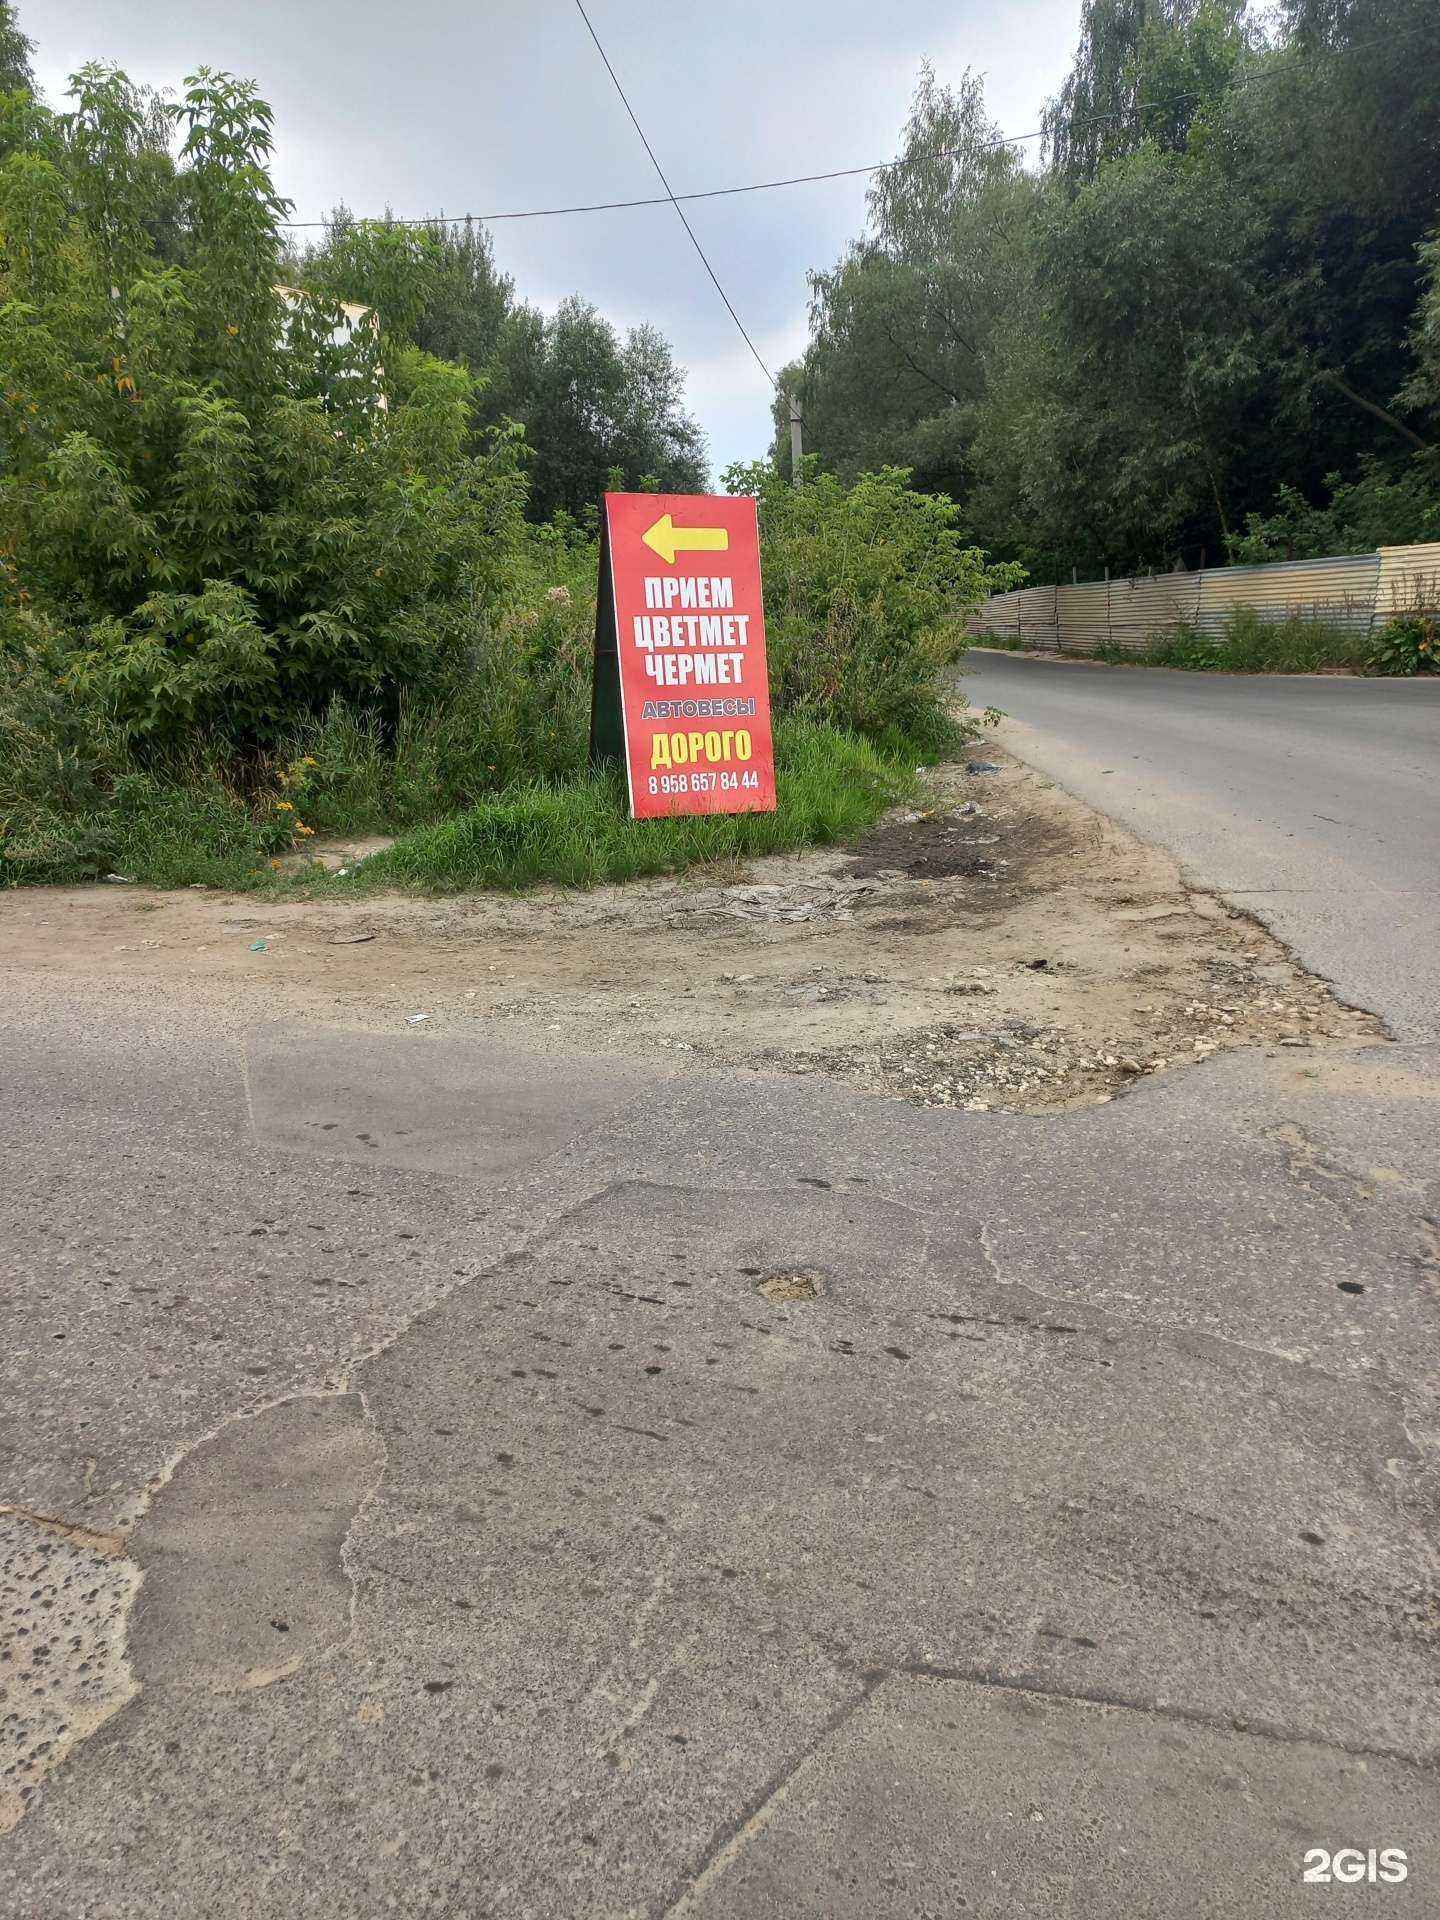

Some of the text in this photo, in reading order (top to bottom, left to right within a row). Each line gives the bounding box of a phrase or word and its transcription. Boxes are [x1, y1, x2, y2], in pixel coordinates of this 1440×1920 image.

[644, 576, 734, 609] ПРИЕМ
[633, 615, 750, 652] ЦВЕТМЕТ
[644, 652, 745, 686] ЧЕРМЕТ
[641, 697, 756, 720] АВТОВЕСЫ
[650, 729, 753, 769] ДОРОГО
[648, 770, 760, 795] 8 958 657 84 44
